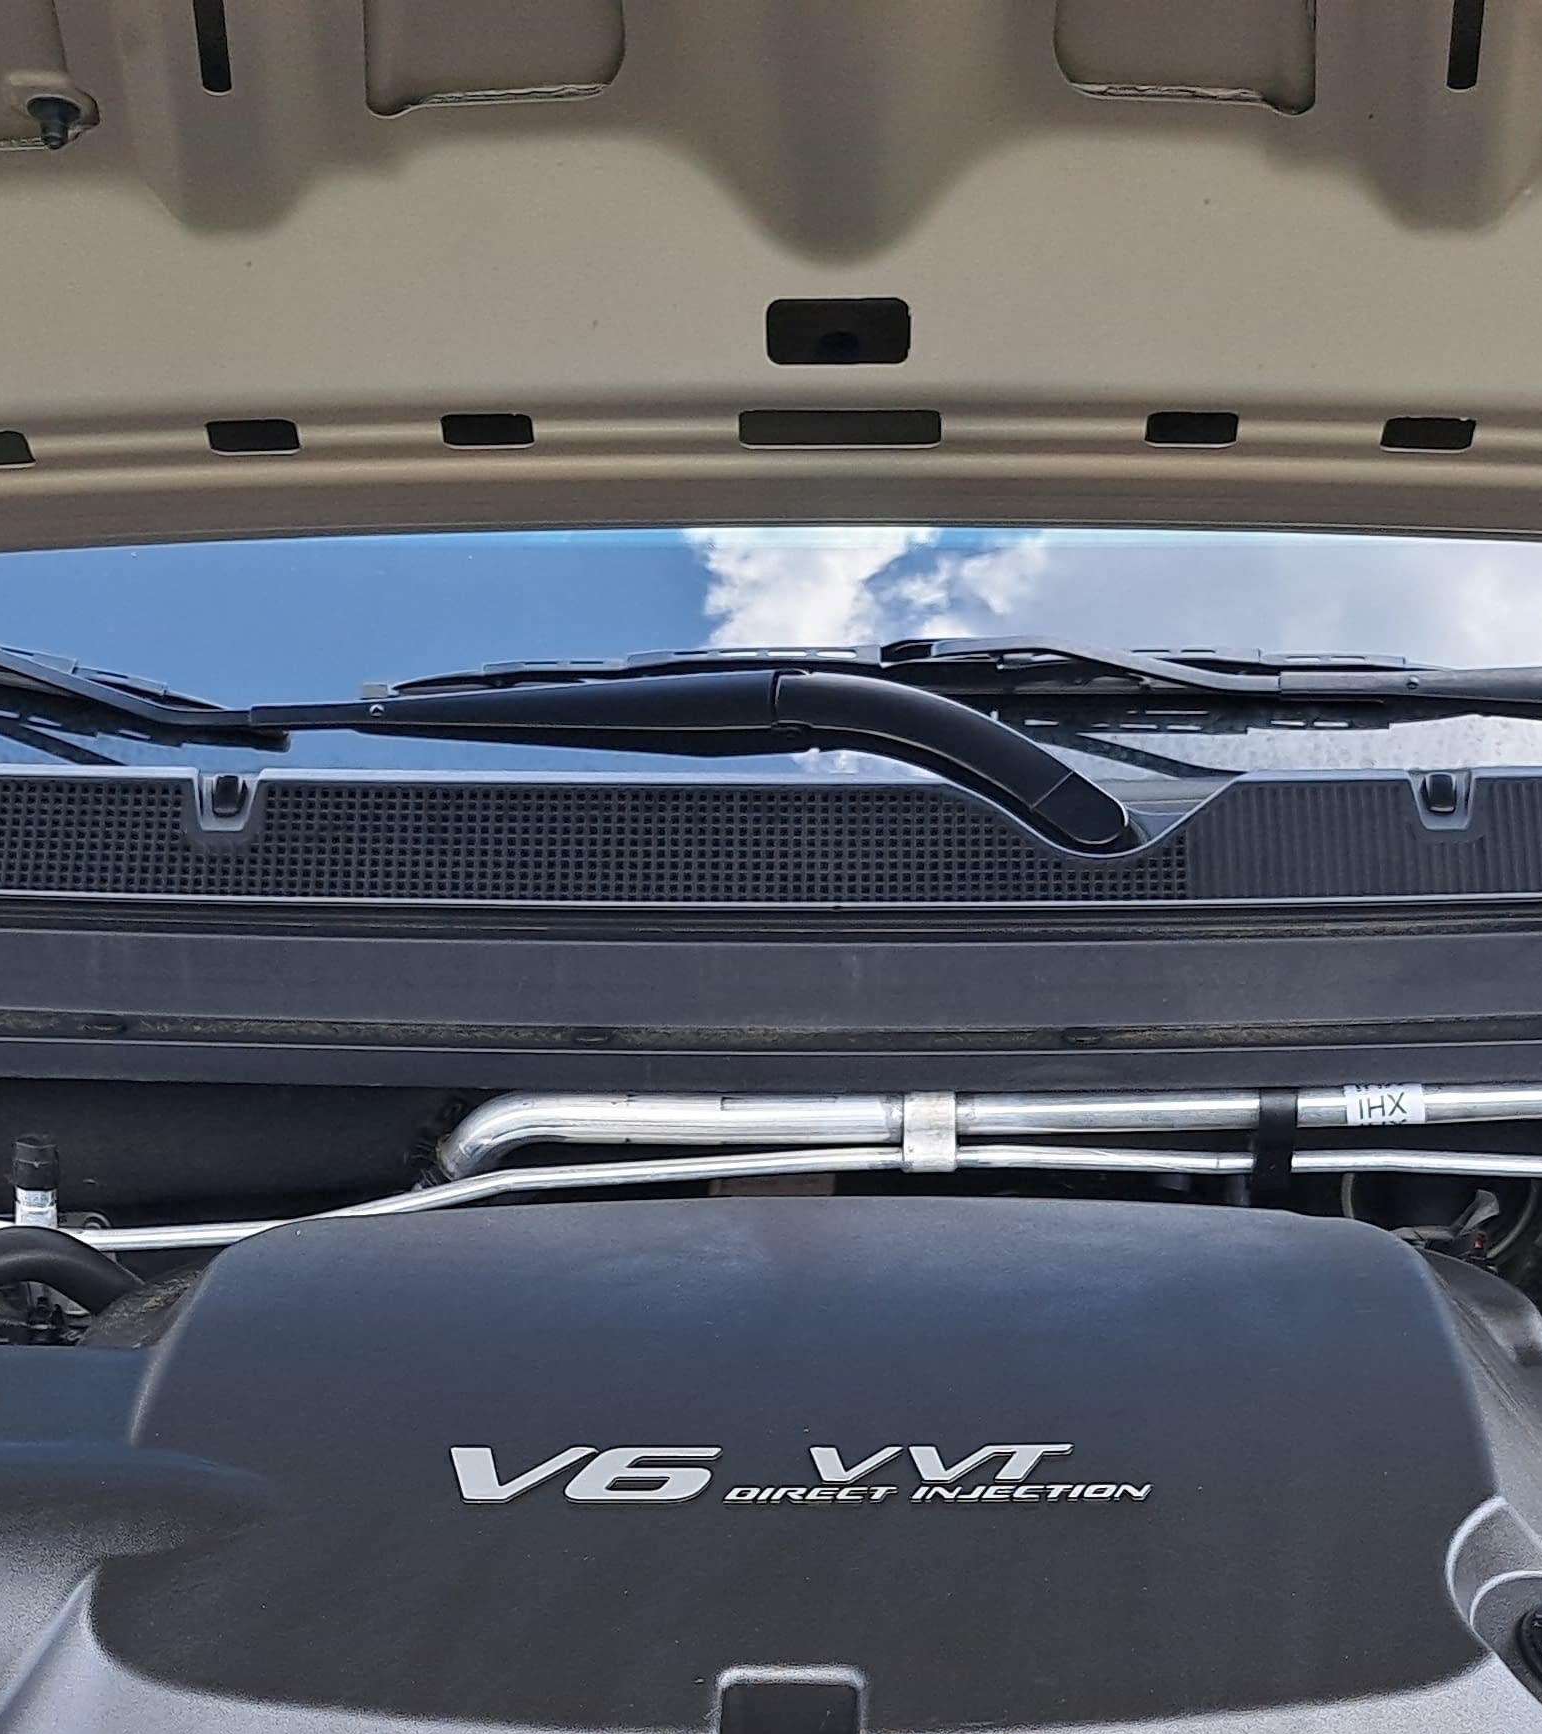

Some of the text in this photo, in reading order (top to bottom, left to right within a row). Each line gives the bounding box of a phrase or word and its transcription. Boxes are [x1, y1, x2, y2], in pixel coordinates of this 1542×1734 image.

[1358, 1091, 1408, 1120] IHX
[450, 1443, 724, 1504] V6
[808, 1442, 1075, 1484] VVT
[723, 1483, 1154, 1506] DIRECT INJECTION
